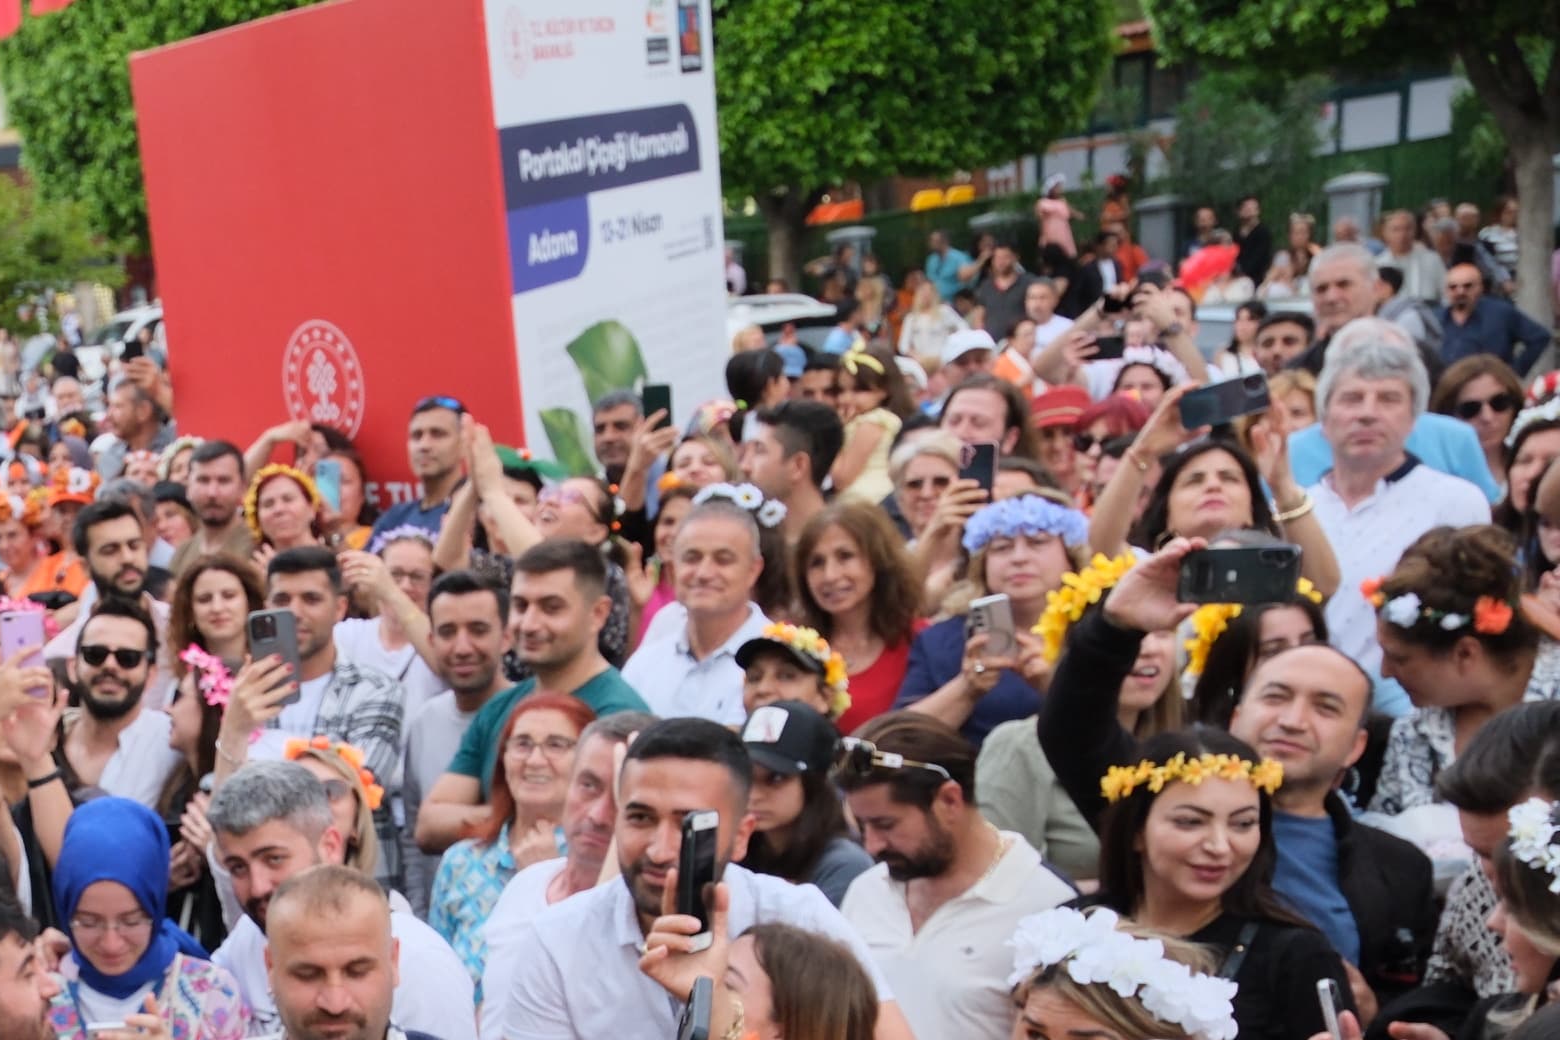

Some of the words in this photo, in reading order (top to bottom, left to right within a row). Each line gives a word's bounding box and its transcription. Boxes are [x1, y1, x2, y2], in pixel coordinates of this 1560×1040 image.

[518, 137, 584, 182] Portakal
[585, 129, 627, 176] Çiçeği
[527, 228, 579, 266] Adana
